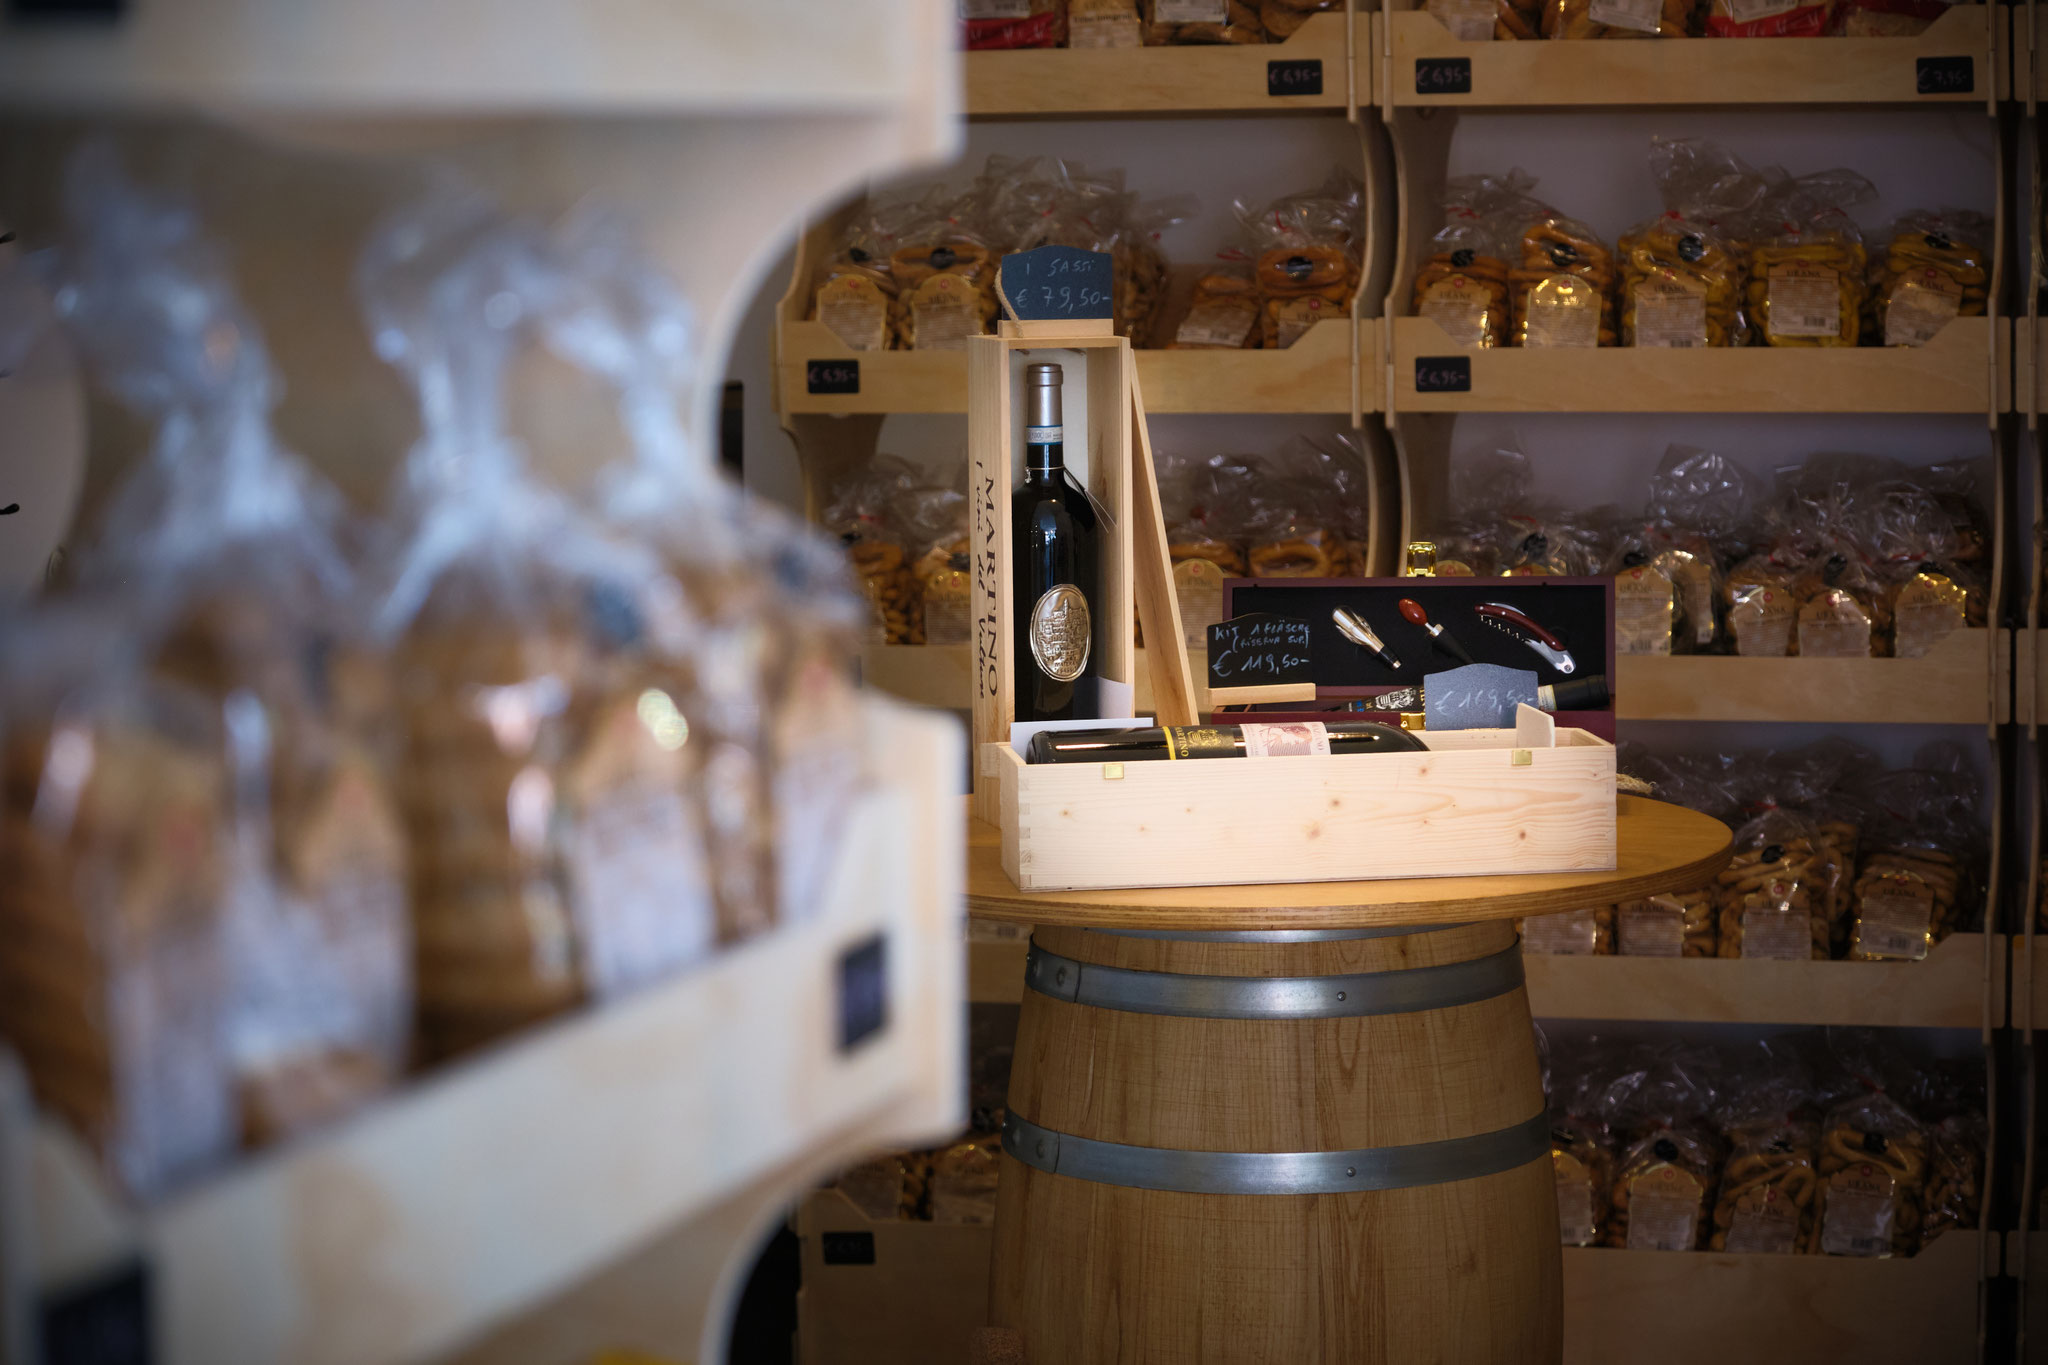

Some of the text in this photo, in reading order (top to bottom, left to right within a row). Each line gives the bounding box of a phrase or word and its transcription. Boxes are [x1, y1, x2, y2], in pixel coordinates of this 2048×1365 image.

[1015, 288, 1029, 307] €
[985, 476, 998, 697] MARTINO
[1212, 649, 1233, 678] €
[1434, 690, 1455, 716] €
[1175, 726, 1189, 757] ARTINO
